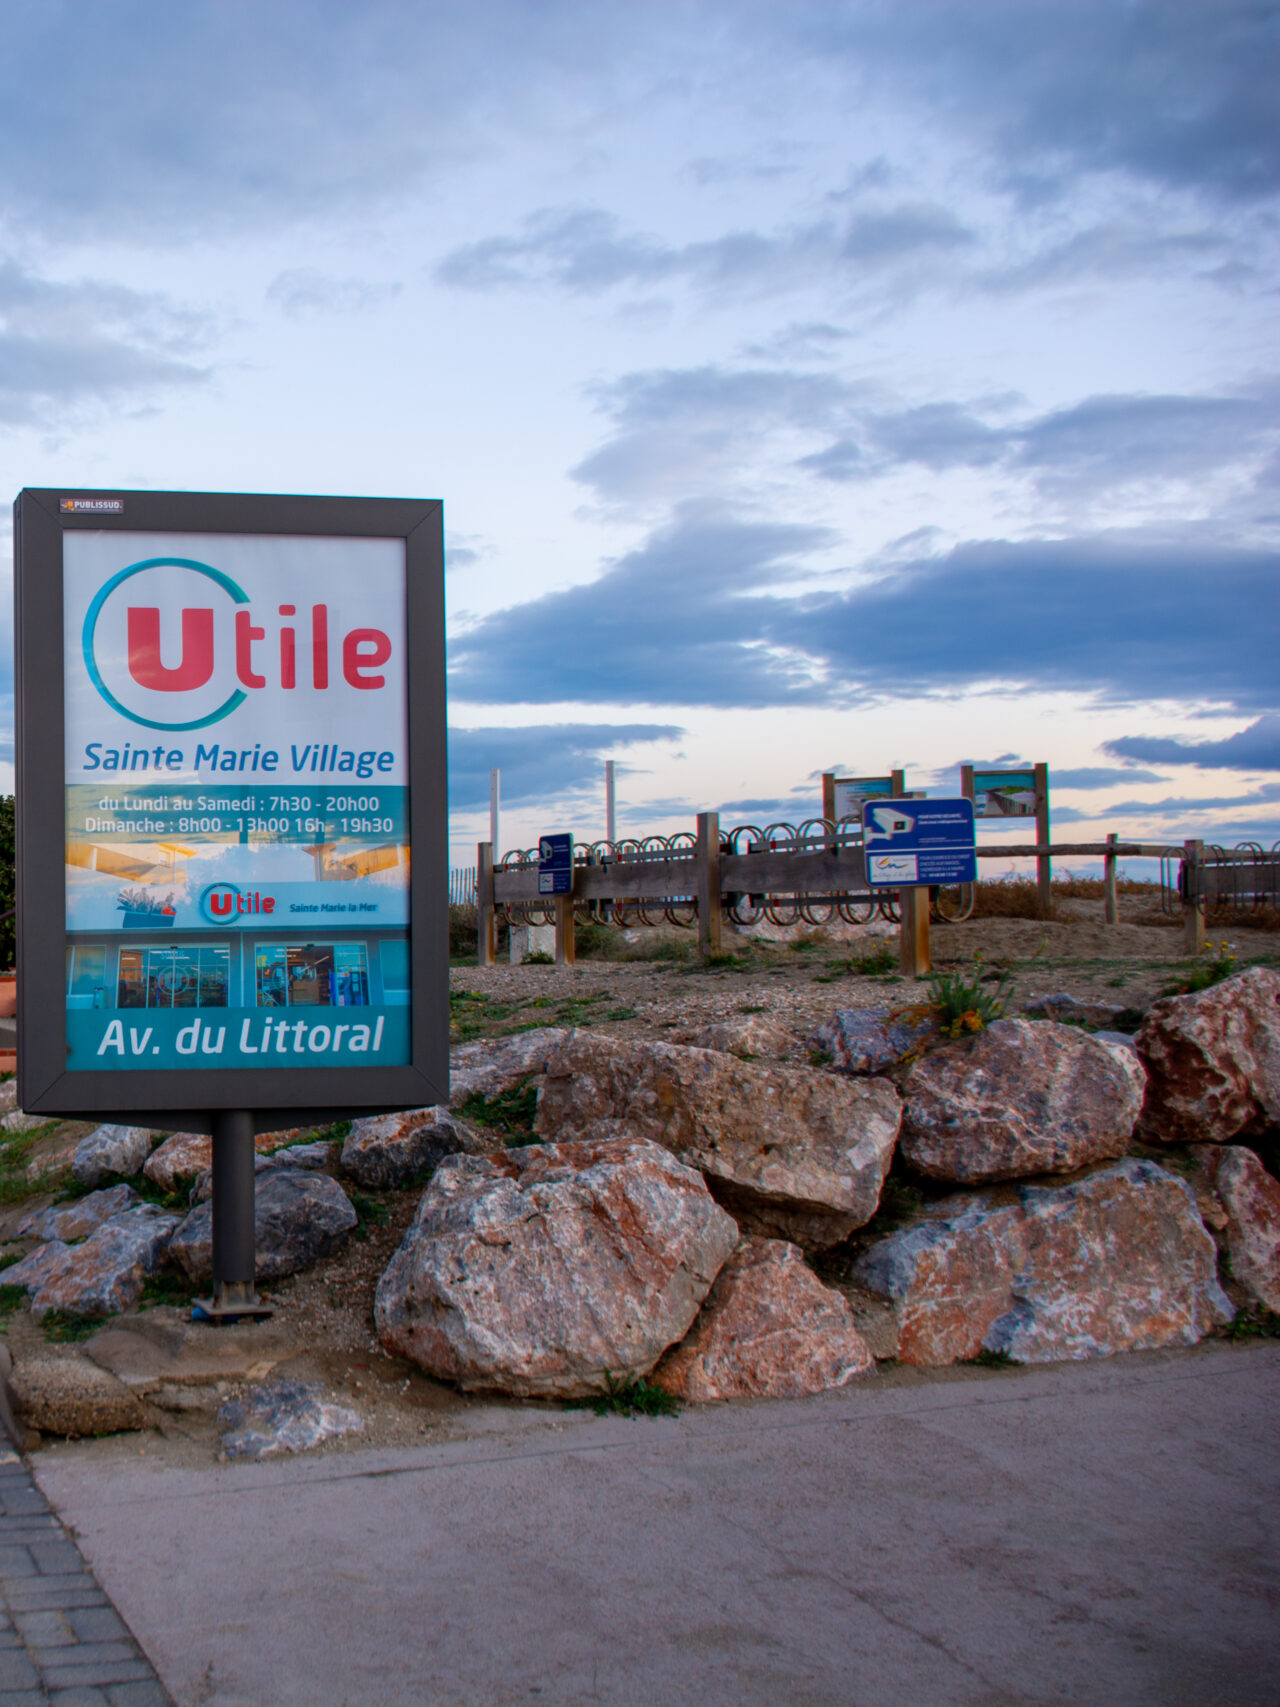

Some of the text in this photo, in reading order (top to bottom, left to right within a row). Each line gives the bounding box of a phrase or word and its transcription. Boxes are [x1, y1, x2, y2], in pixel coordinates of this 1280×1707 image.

[127, 604, 392, 692] Utile
[83, 743, 394, 778] Sainte Marie Village
[99, 797, 119, 811] du
[123, 797, 166, 811] Lundi
[173, 800, 192, 811] au
[197, 797, 255, 811] Samedi
[270, 797, 310, 811] 7h30
[326, 797, 379, 811] 20h00
[85, 818, 164, 832] Dimanche
[178, 818, 221, 832] 8h00
[238, 818, 289, 832] 13h00
[296, 818, 325, 833] 16h
[341, 818, 392, 833] 19h30
[210, 892, 275, 915] Utile
[289, 904, 319, 912] Sainte
[321, 903, 346, 912] Marie
[359, 903, 377, 911] Mer
[97, 1016, 384, 1056] Av. du Littoral
